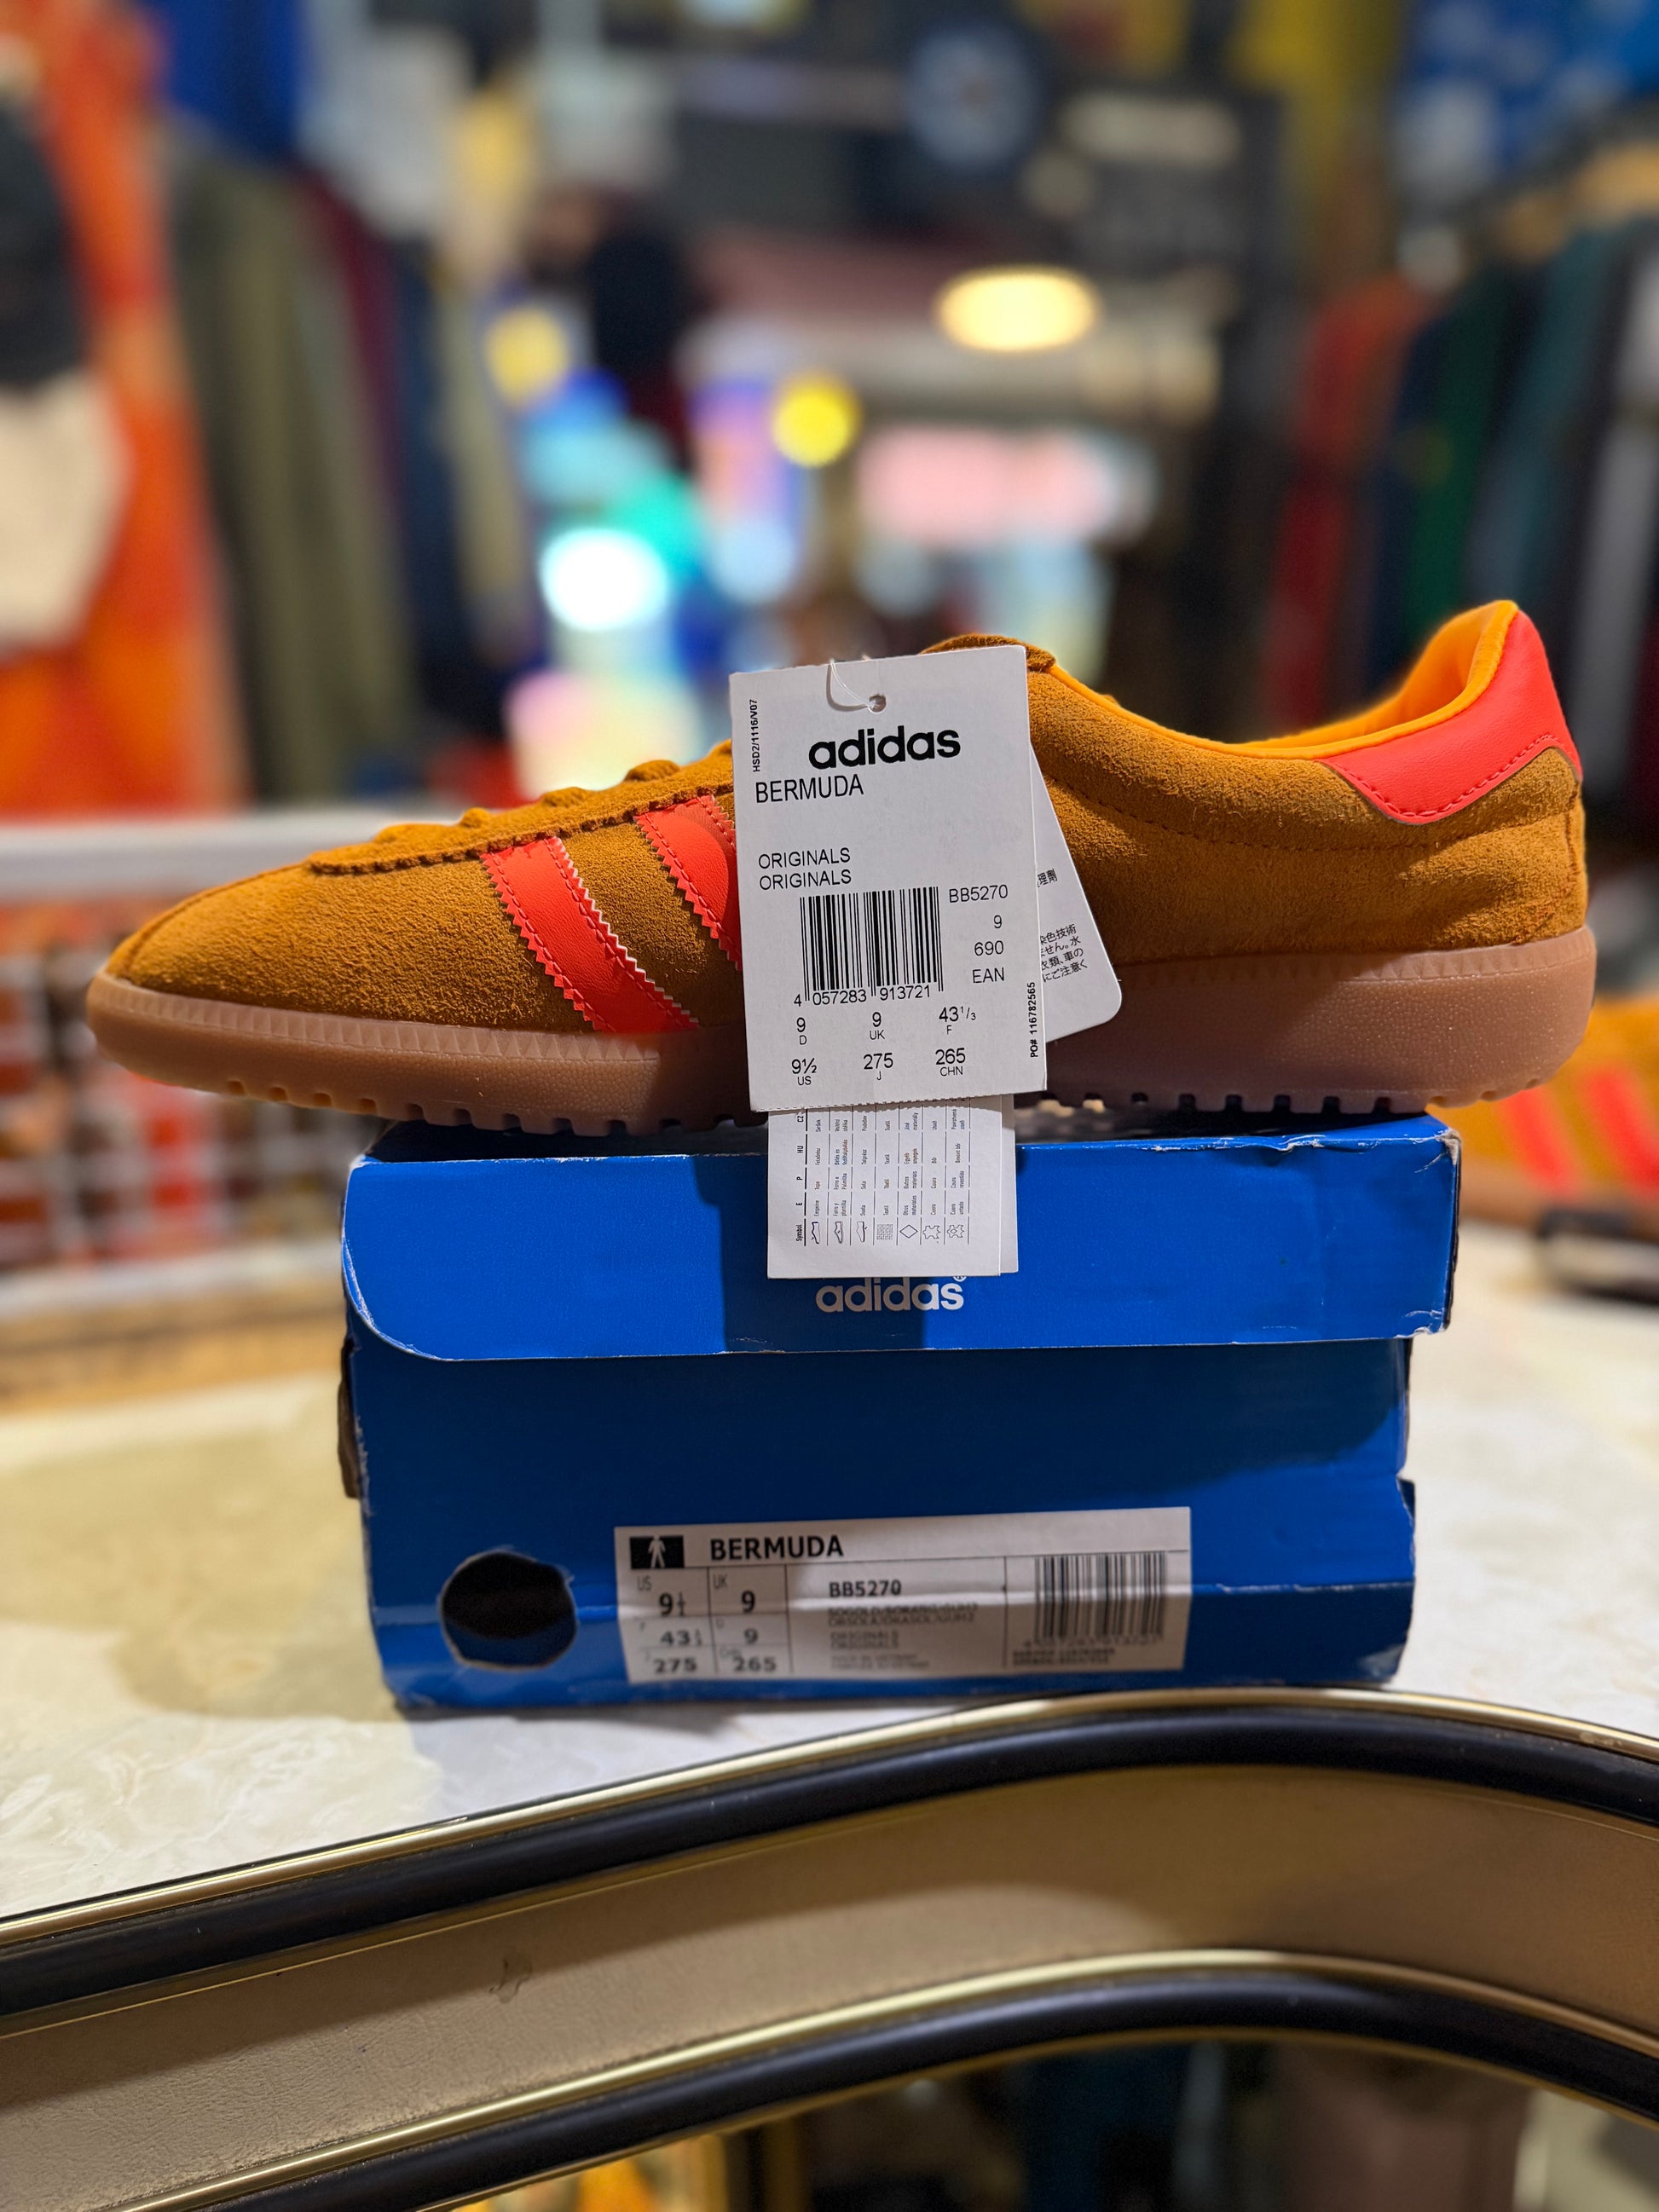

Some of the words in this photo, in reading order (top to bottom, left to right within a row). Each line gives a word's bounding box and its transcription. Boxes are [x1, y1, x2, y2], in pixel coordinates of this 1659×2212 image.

[749, 700, 760, 772] HSD2/1116/V07
[809, 725, 961, 769] adidas
[755, 774, 864, 803] BERMUDA
[759, 847, 851, 869] ORIGINALS
[760, 869, 852, 890] ORIGINALS
[1038, 869, 1057, 887] 理剤
[949, 884, 1009, 903] BB5270
[993, 915, 1002, 928] 9
[974, 940, 1004, 956] 690
[973, 967, 1005, 984] EAN
[794, 994, 801, 1007] 4
[812, 990, 867, 1006] 057283
[880, 985, 930, 1001] 913721
[1027, 982, 1038, 1034] 116782565
[797, 1018, 806, 1032] 9
[873, 1012, 882, 1027] 9
[800, 1035, 806, 1045] D
[870, 1030, 885, 1040] UK
[947, 1025, 952, 1034] F
[864, 1053, 893, 1069] 275
[935, 1048, 966, 1065] 265
[798, 1076, 812, 1085] US
[877, 1071, 882, 1080] J
[940, 1066, 963, 1076] CHN
[815, 1278, 964, 1313] adidas
[710, 1535, 844, 1561] BERMUDA
[638, 1576, 651, 1591] US
[713, 1574, 728, 1589] UK
[829, 1580, 902, 1597] BB5270
[741, 1591, 755, 1614] 9
[743, 1629, 759, 1644] 9
[654, 1657, 697, 1674] 275
[734, 1657, 777, 1672] 265
